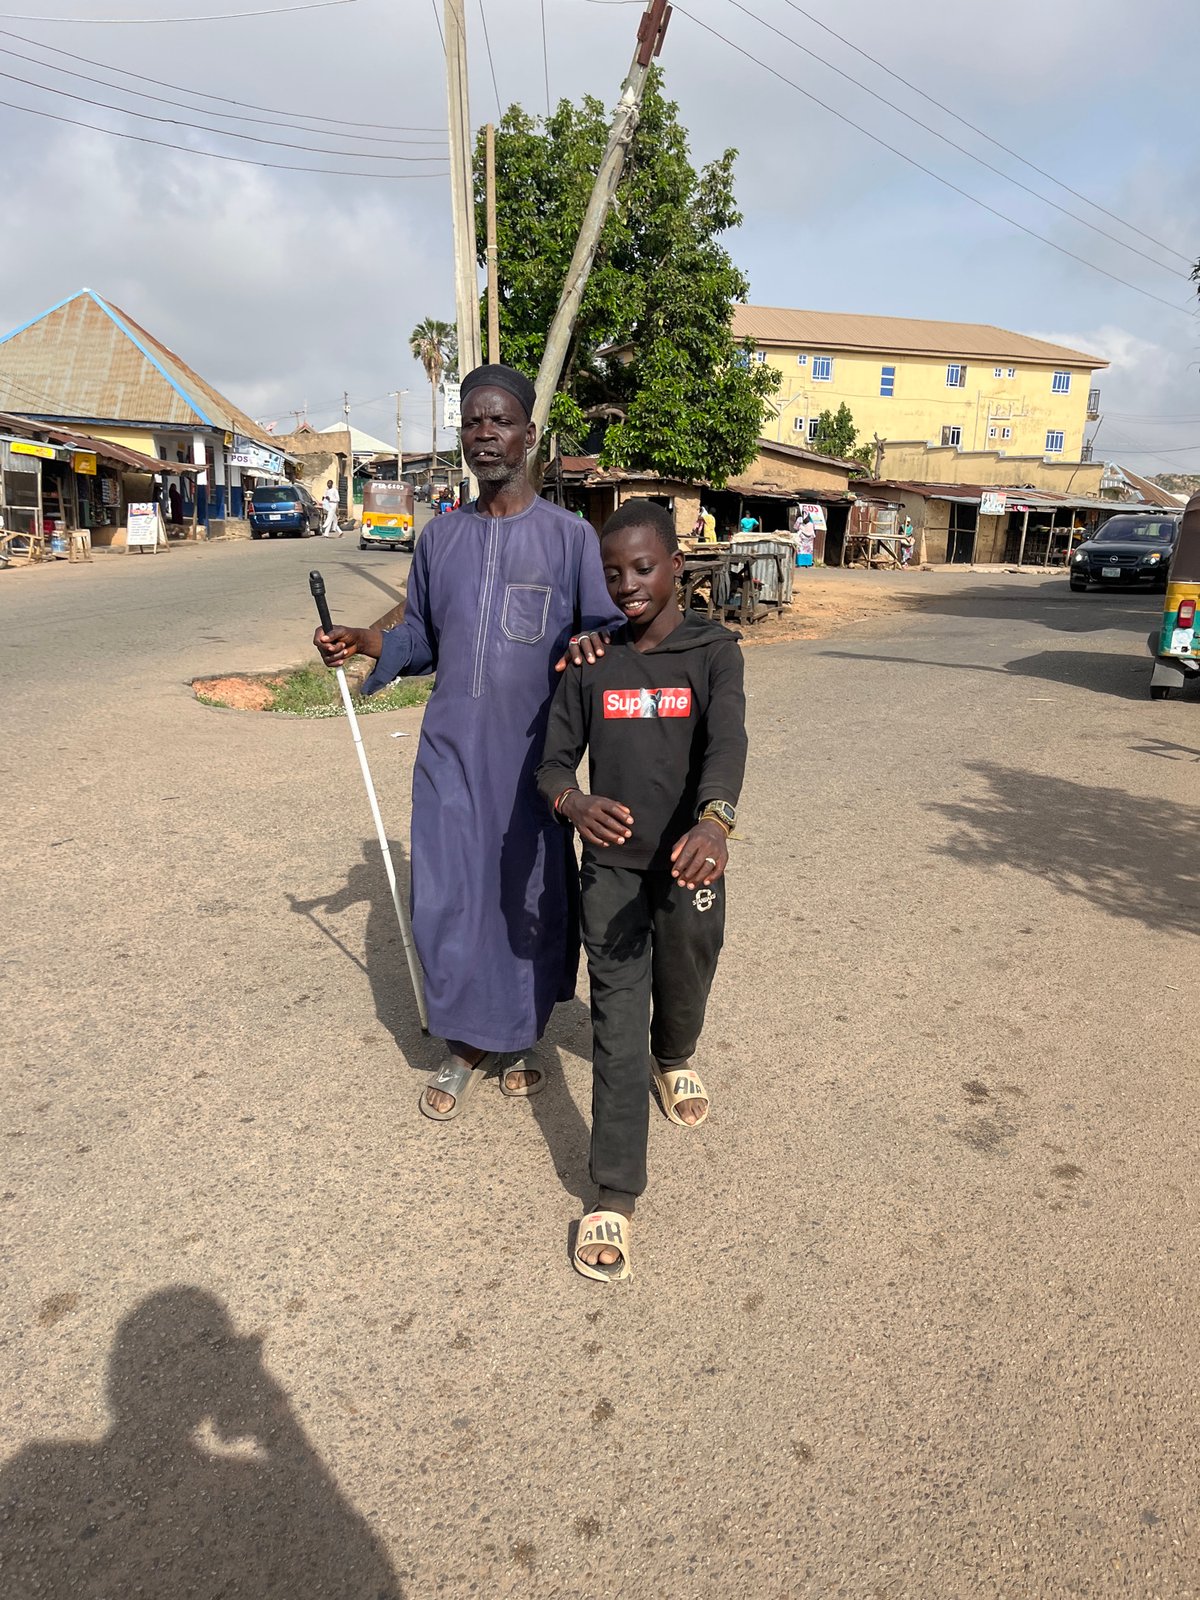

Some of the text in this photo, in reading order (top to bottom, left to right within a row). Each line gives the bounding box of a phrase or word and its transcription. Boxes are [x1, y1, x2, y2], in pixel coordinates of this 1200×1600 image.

[231, 455, 248, 463] POS
[132, 502, 154, 511] POS
[606, 694, 689, 715] Supme
